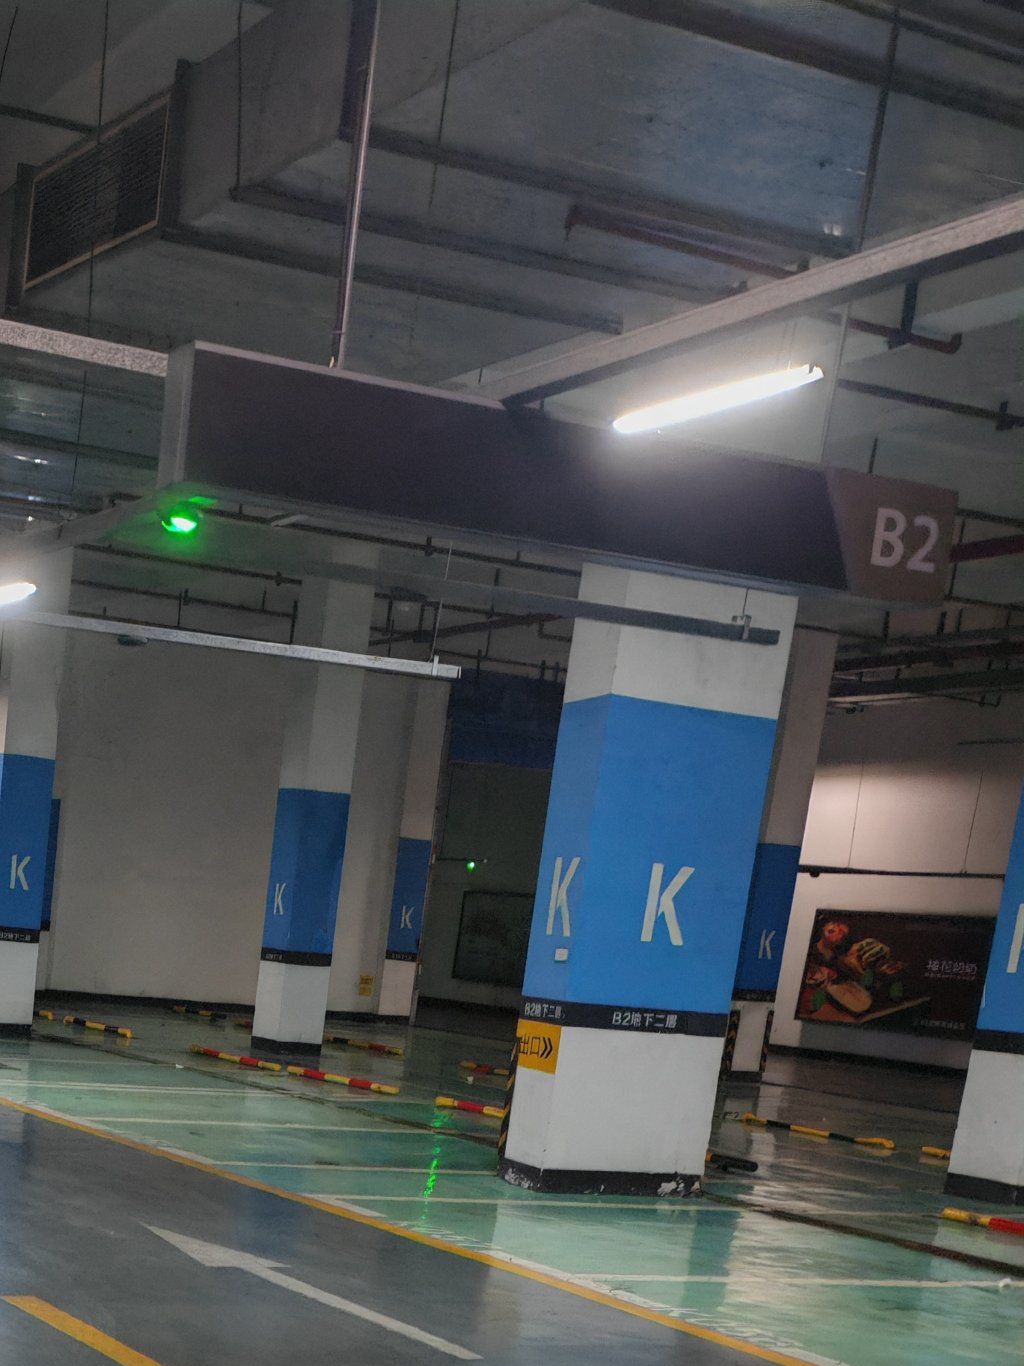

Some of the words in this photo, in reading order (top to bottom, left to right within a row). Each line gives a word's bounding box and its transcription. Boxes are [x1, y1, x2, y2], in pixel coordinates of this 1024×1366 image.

[870, 508, 940, 573] B2
[9, 854, 32, 891] K
[273, 882, 287, 915] K
[546, 857, 581, 937] K
[641, 862, 695, 946] K
[400, 905, 416, 929] K
[758, 929, 776, 960] K
[612, 1011, 678, 1029] B2地下二层
